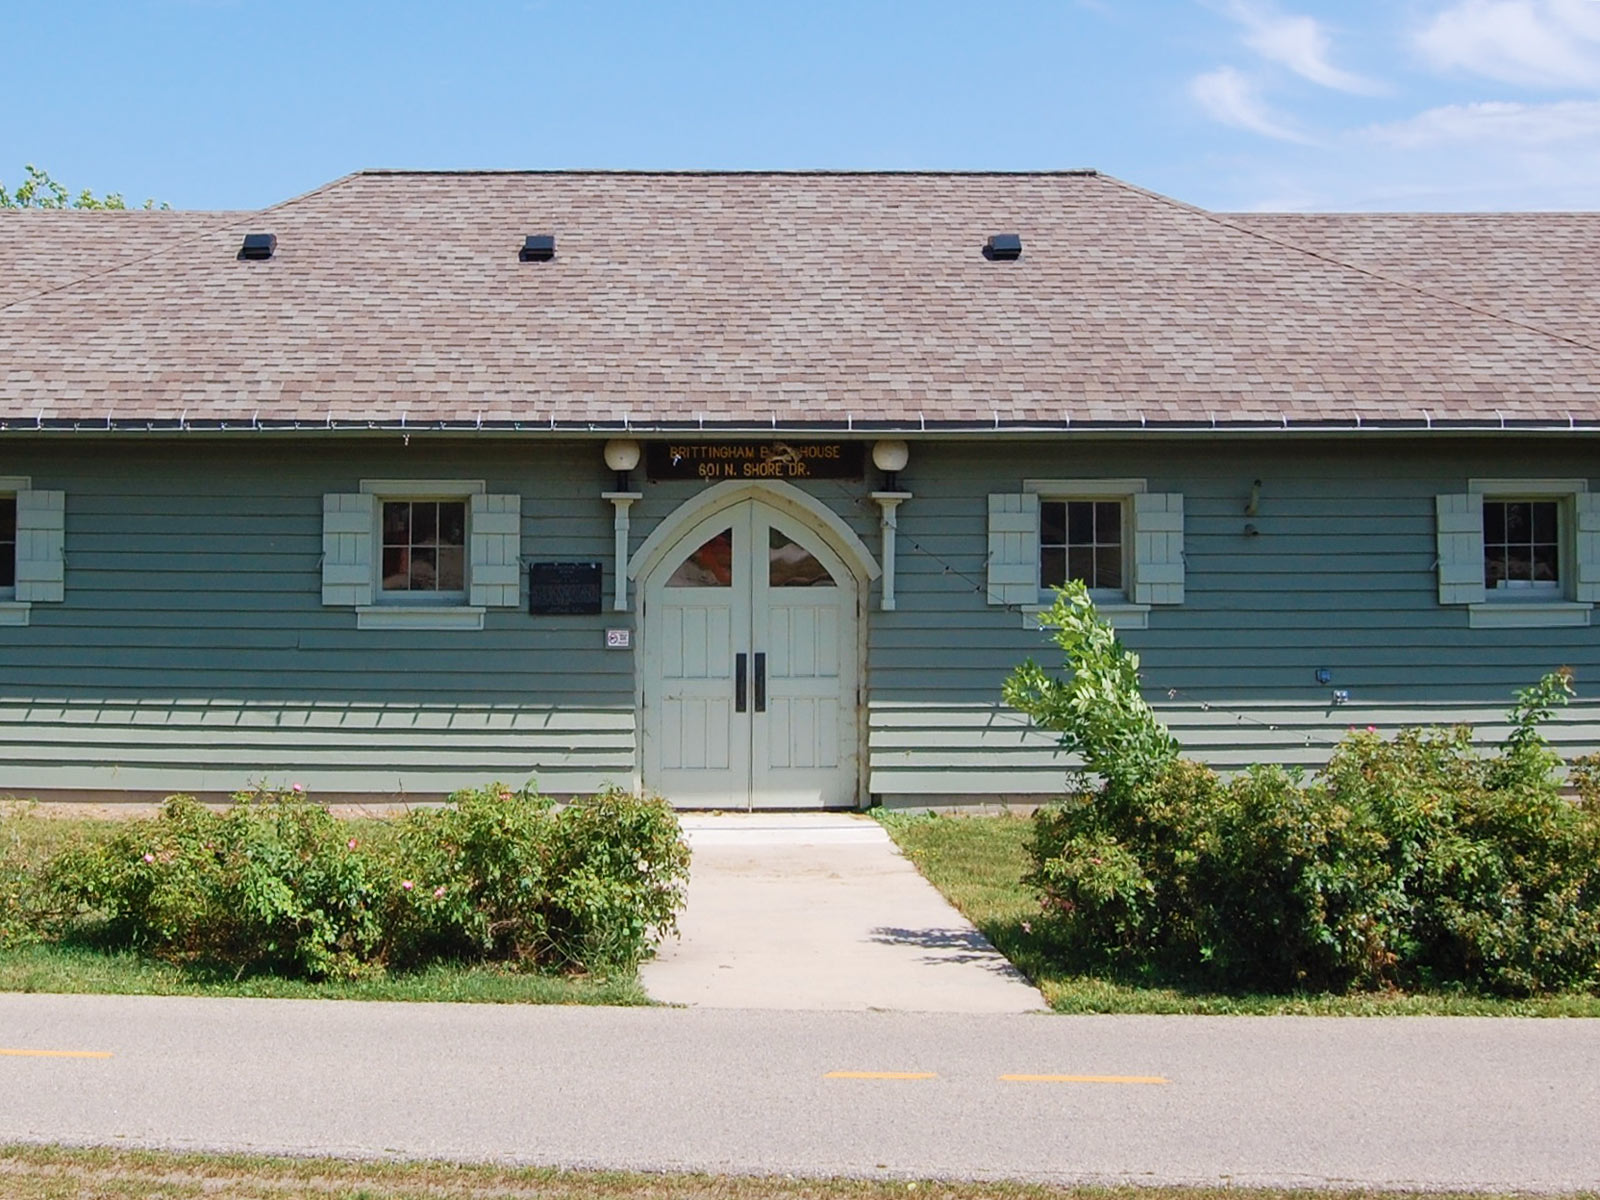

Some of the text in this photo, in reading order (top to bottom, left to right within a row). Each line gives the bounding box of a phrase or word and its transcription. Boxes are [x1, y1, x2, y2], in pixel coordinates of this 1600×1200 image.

[669, 445, 755, 459] BRITTINGHAM
[724, 463, 738, 476] N.
[743, 463, 784, 476] SHORE
[788, 462, 811, 476] DR.
